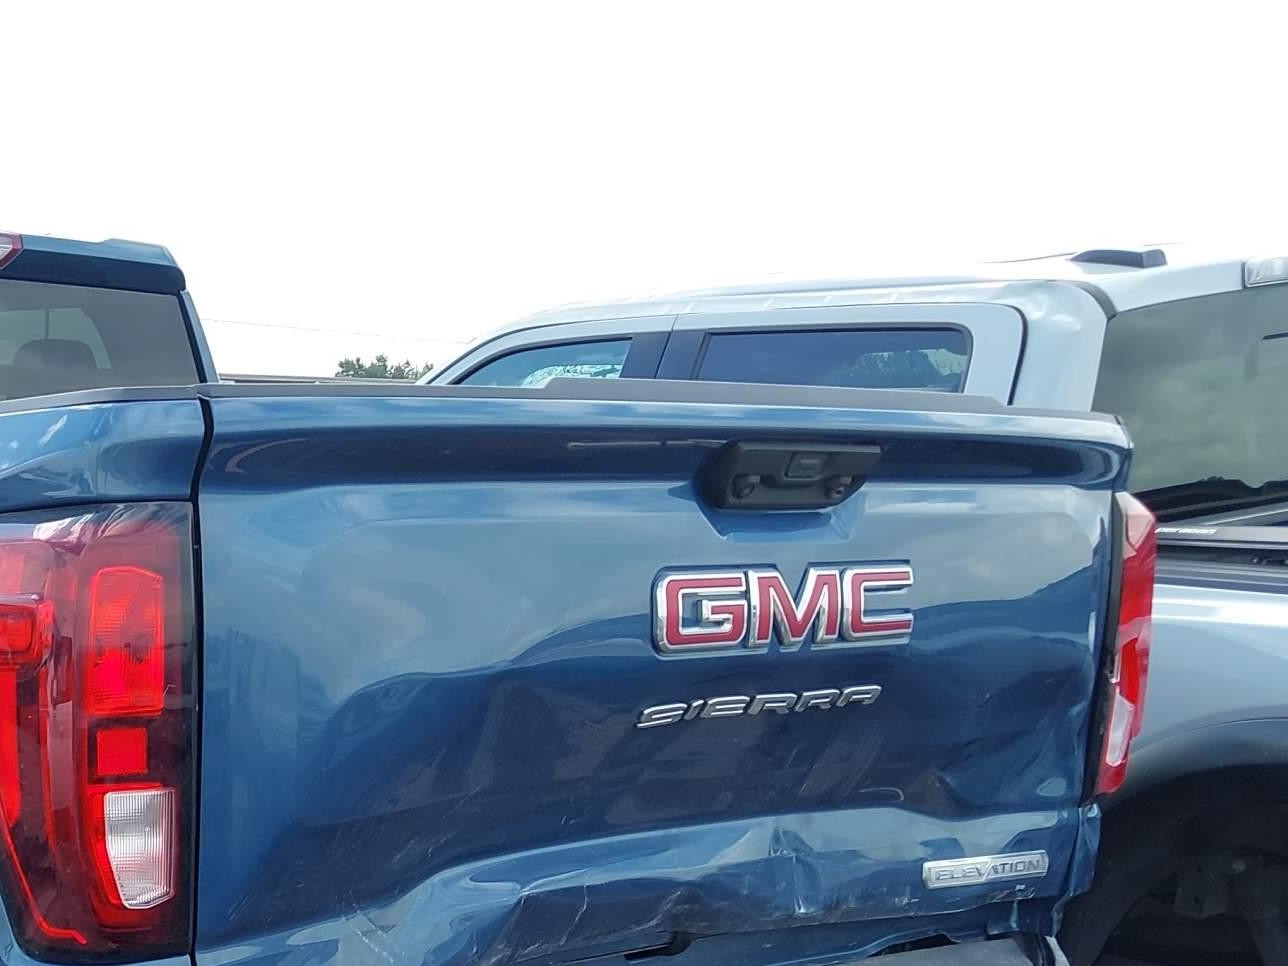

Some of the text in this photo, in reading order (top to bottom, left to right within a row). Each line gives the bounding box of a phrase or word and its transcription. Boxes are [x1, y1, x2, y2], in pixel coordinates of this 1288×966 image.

[653, 563, 913, 657] GMC
[636, 684, 883, 729] SIERRA
[932, 857, 1043, 882] ELEVATION
